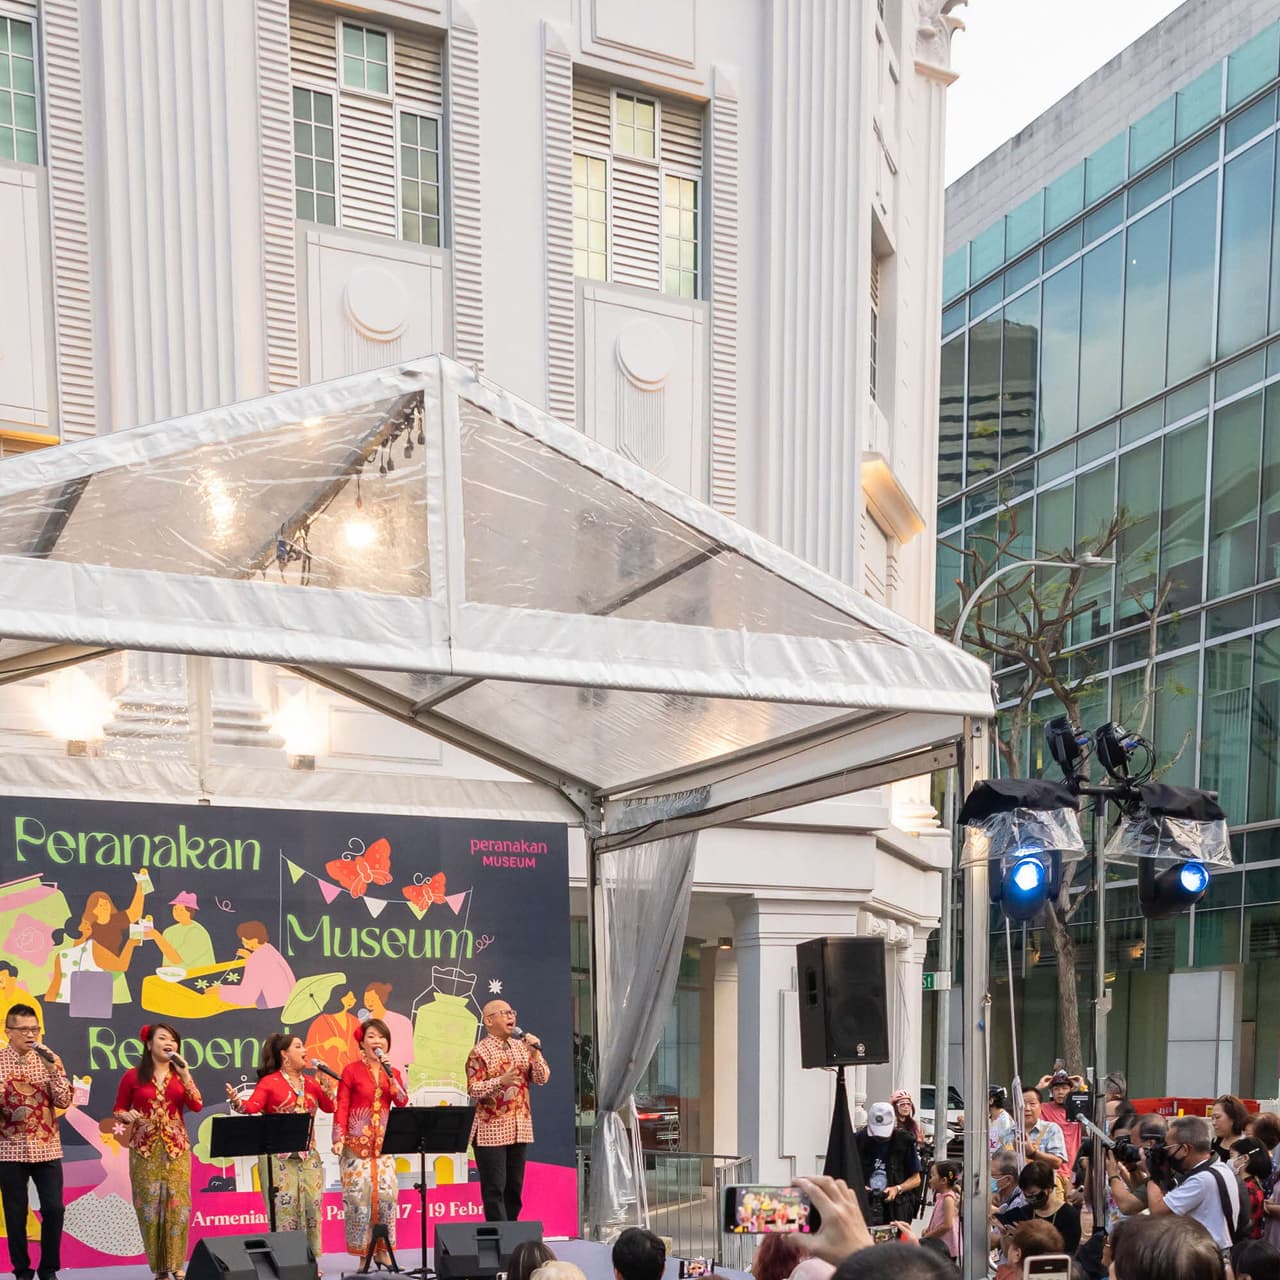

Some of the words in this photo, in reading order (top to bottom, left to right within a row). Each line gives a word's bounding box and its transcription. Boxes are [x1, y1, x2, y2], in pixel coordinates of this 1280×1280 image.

[14, 815, 261, 871] Peranakan
[470, 839, 548, 855] peranakan
[482, 855, 536, 868] MUSEUM
[287, 913, 473, 959] Museum
[396, 1203, 412, 1219] 17
[428, 1202, 445, 1217] 19
[449, 1201, 484, 1217] Febr
